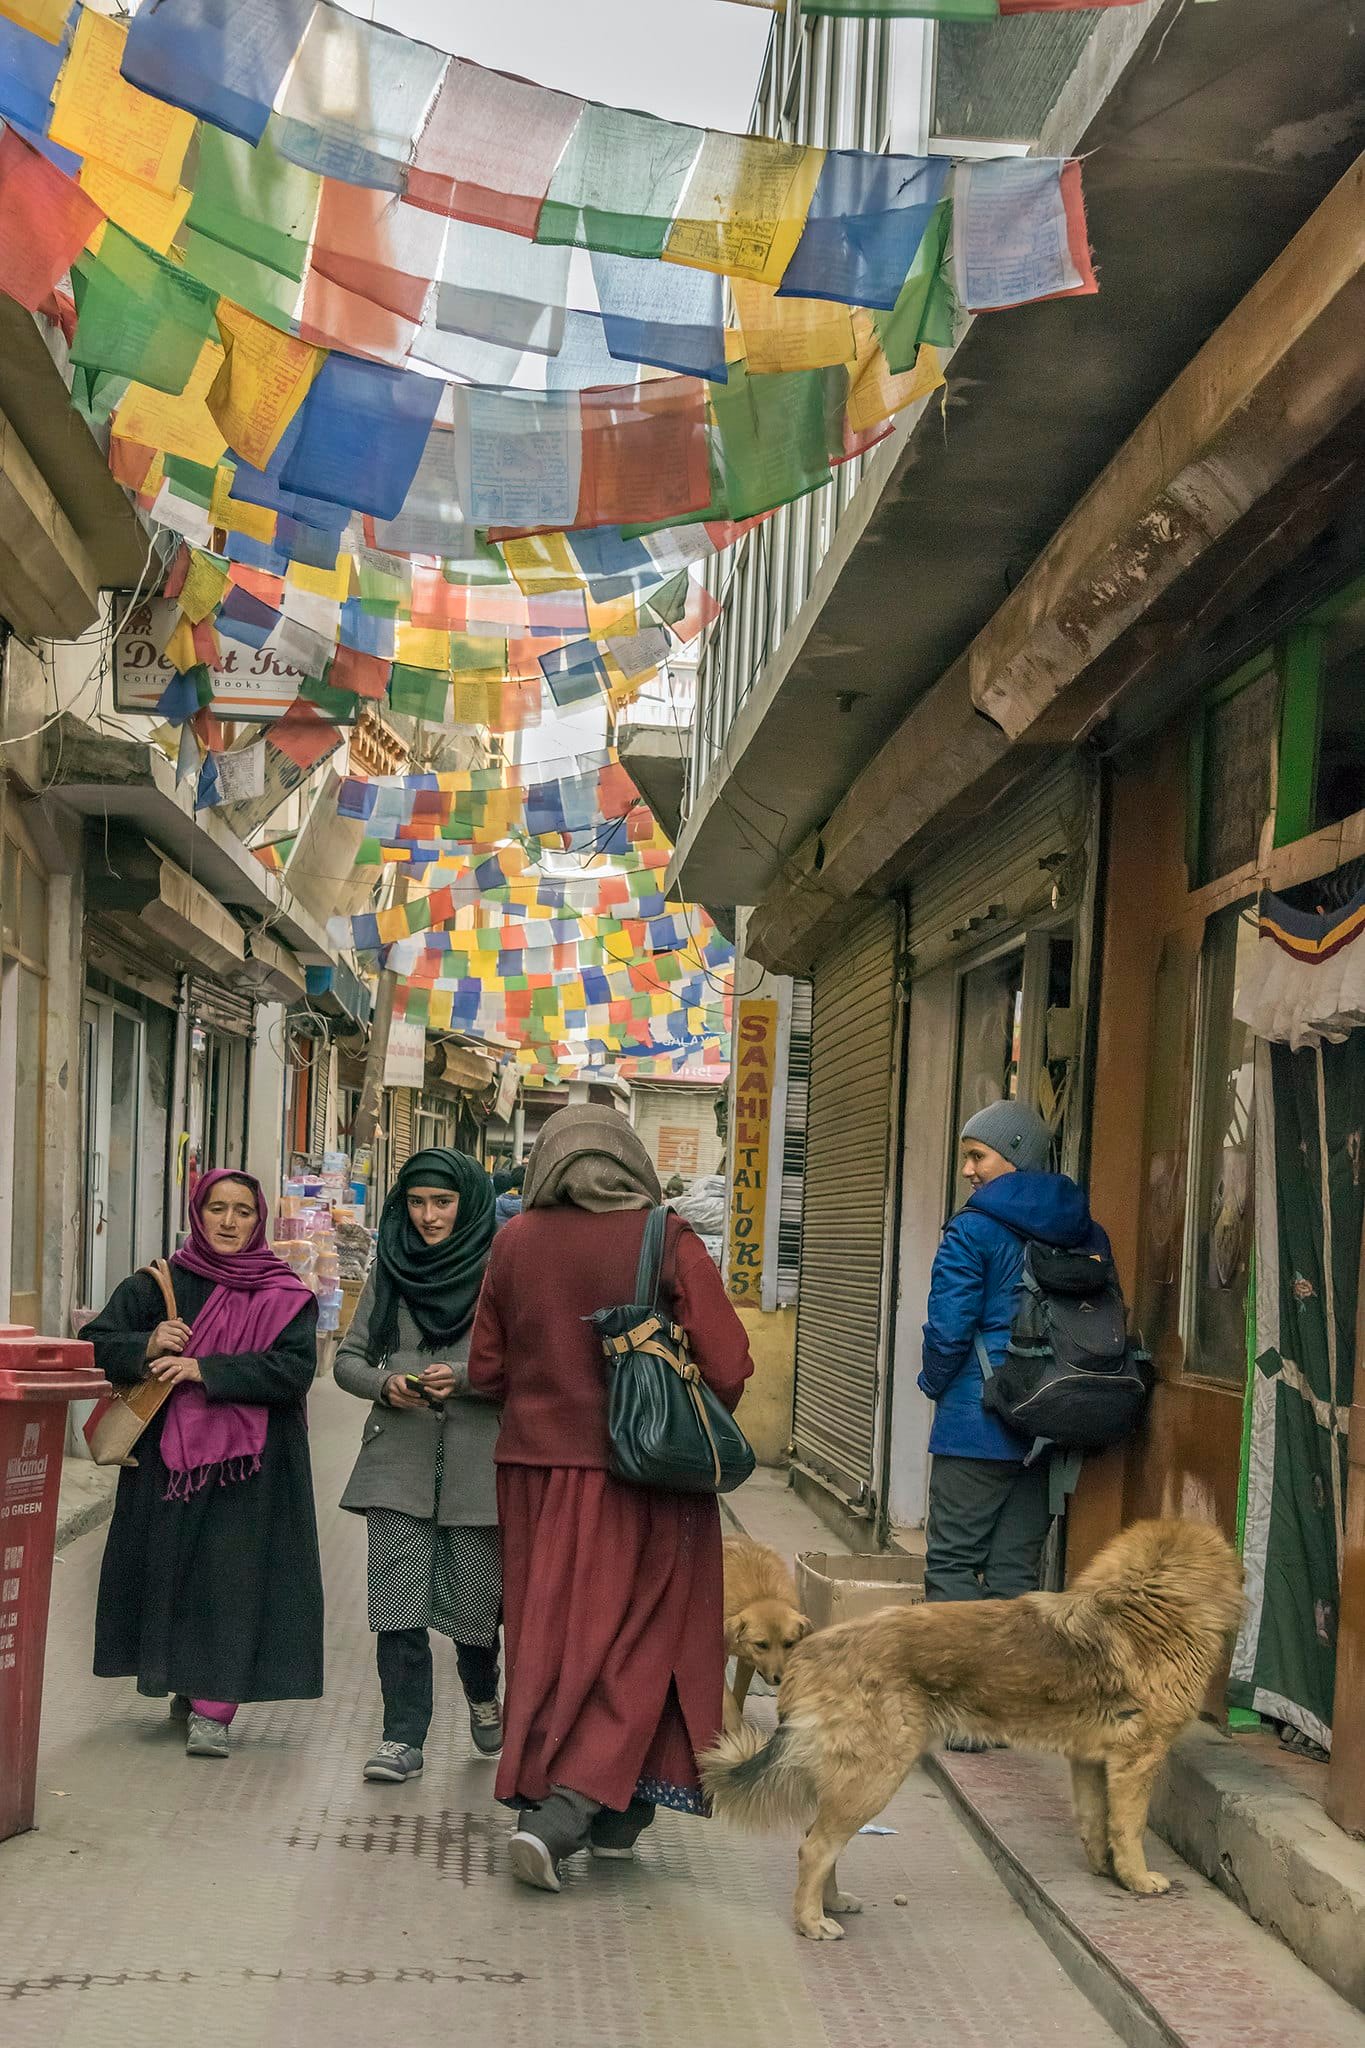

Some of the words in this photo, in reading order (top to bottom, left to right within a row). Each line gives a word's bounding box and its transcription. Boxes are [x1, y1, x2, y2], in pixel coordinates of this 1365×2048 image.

[214, 680, 261, 689] Books
[731, 1148, 762, 1295] TAILORS
[12, 1502, 42, 1516] GREEN
